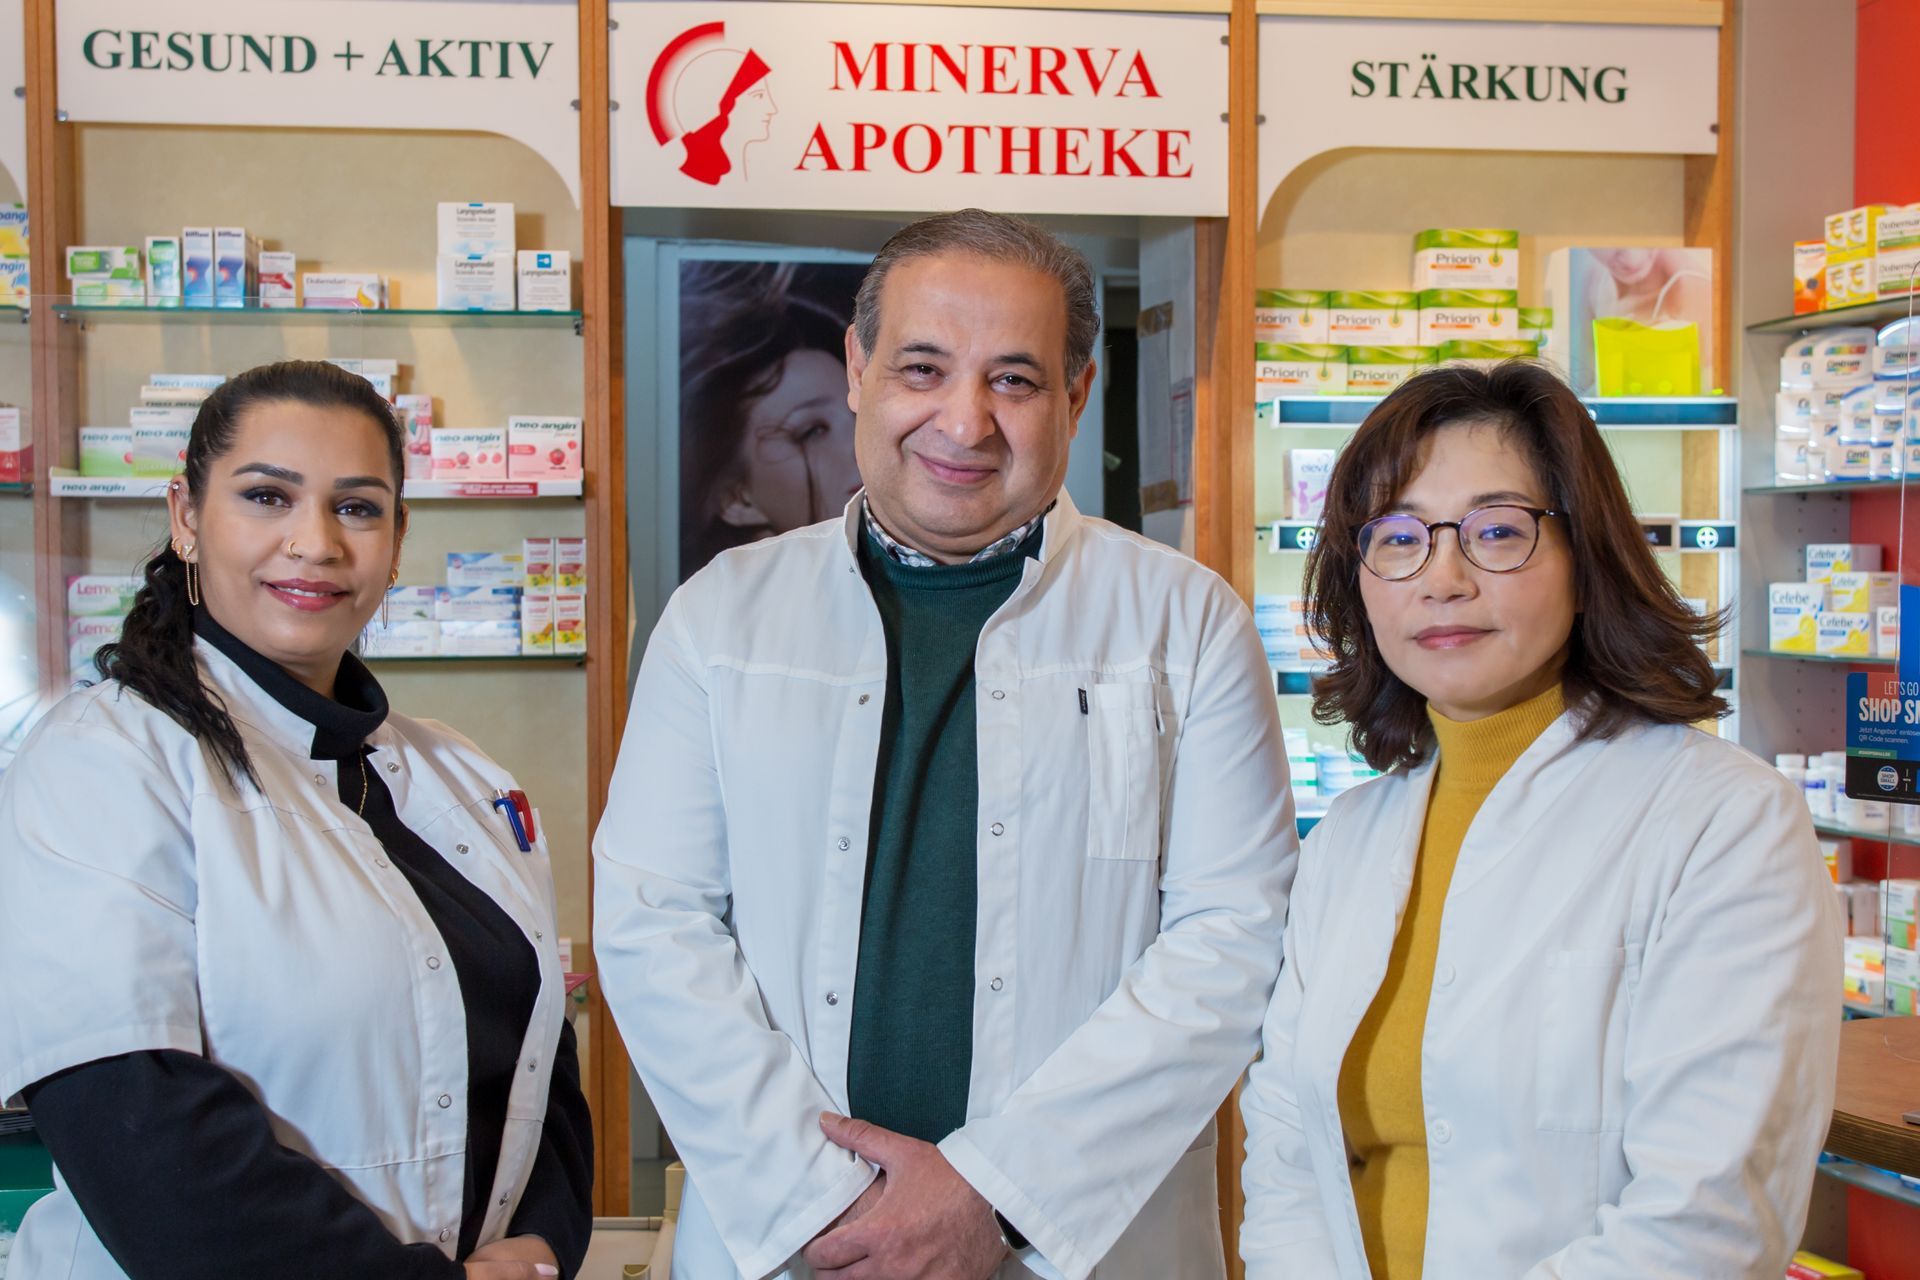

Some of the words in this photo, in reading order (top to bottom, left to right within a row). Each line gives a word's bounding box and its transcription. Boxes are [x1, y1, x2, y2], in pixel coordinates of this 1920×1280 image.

[82, 29, 318, 73] GESUND
[333, 40, 364, 71] +
[376, 38, 554, 80] AKTIV
[828, 40, 1162, 98] MINERVA
[1351, 53, 1627, 103] STÄRKUNG
[794, 120, 1194, 179] APOTHEKE
[1436, 253, 1481, 266] Priorin
[1336, 314, 1381, 326] Priorin
[1435, 312, 1480, 325] Priorin
[1263, 366, 1308, 379] Priorin
[1353, 369, 1399, 382] Priorin
[514, 422, 539, 430] neo
[541, 421, 577, 432] angin
[82, 434, 109, 442] neo
[135, 429, 163, 438] neo
[435, 434, 460, 443] neo
[462, 433, 501, 444] angin
[61, 483, 88, 491] neo
[89, 483, 126, 492] angin
[1884, 680, 1906, 696] LET'S
[1906, 681, 1919, 697] GO
[1858, 697, 1902, 723] SHOP
